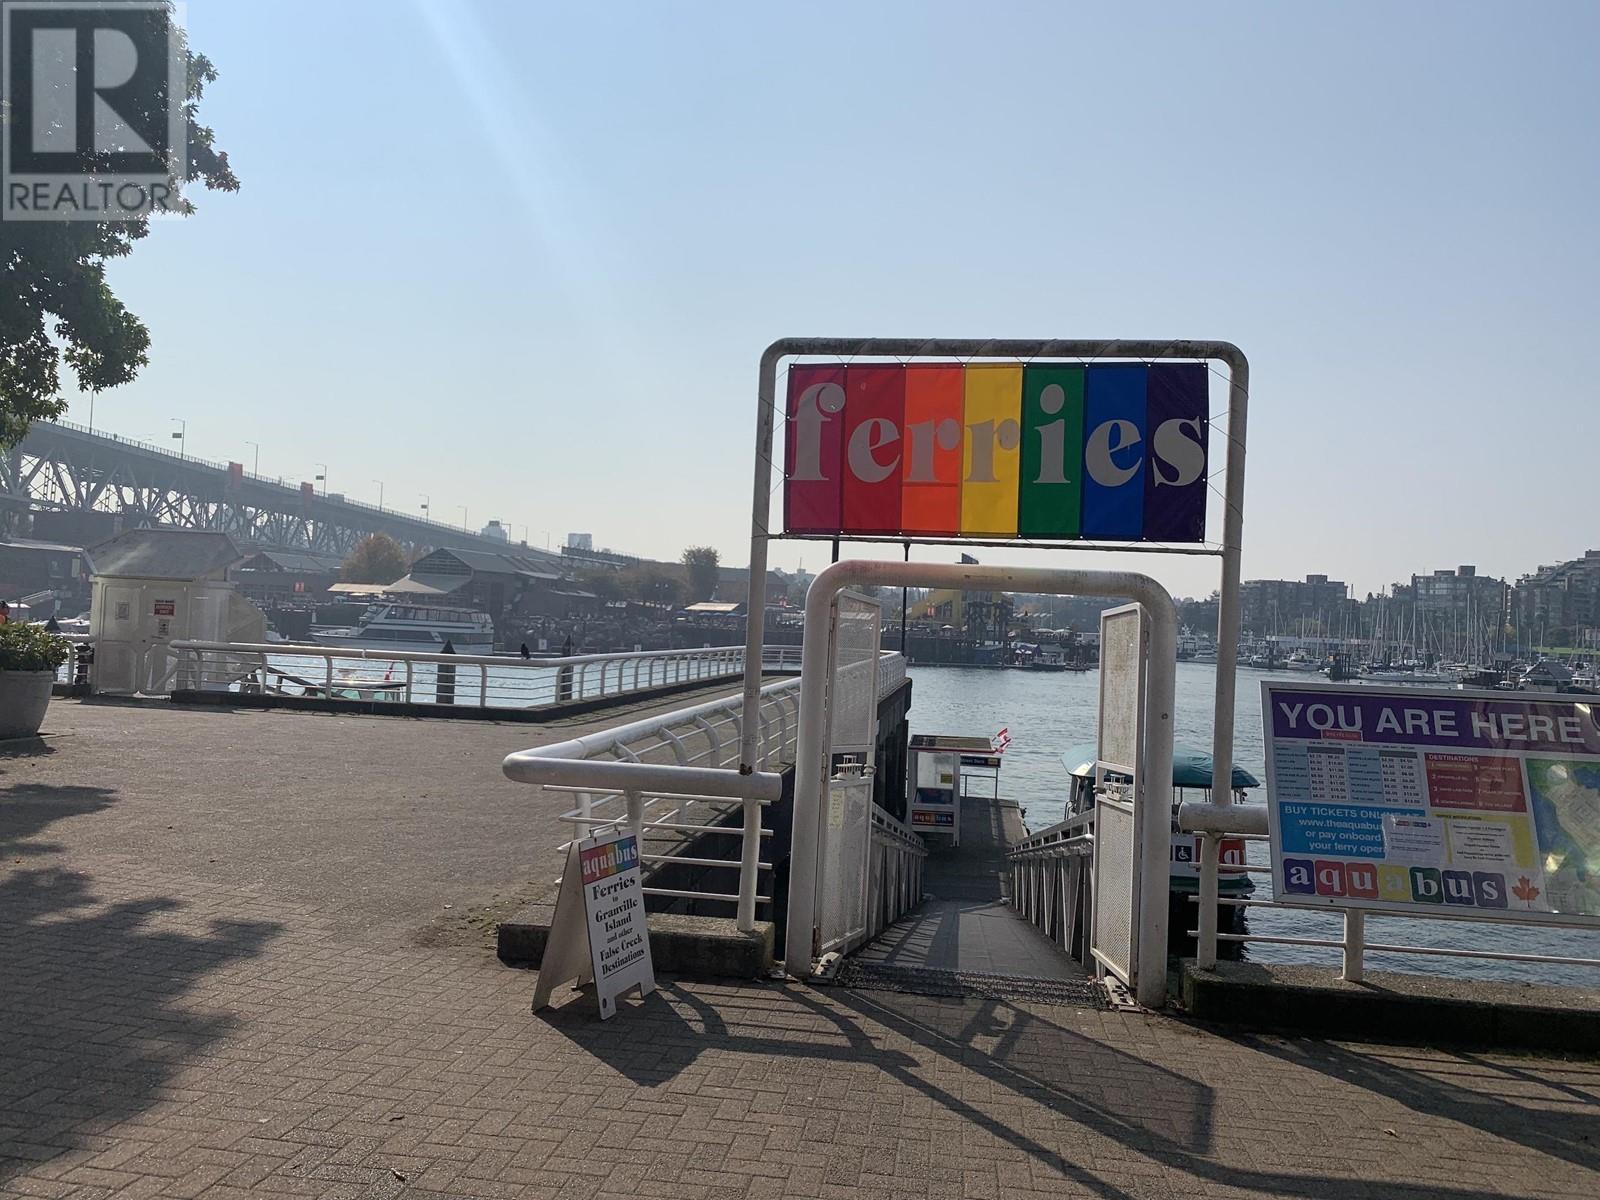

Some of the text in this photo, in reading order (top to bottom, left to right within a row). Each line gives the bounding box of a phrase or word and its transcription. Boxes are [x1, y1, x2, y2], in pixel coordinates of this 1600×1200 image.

[788, 382, 1205, 487] ferries
[1279, 702, 1586, 744] YOU ARE HERE
[1428, 754, 1479, 763] DESTINATIONS
[1285, 805, 1307, 815] BUY
[1312, 807, 1357, 818] TICKETS
[1298, 819, 1383, 831] www.theaquabu
[1318, 831, 1336, 841] pay
[1339, 832, 1381, 841] onboard
[582, 843, 638, 877] aquabus
[1309, 842, 1385, 854] your ferry oper
[592, 874, 636, 900] Ferries
[1290, 866, 1499, 900] aquabus
[595, 898, 638, 923] Granville
[604, 912, 632, 933] Island
[606, 927, 633, 944] and other
[600, 935, 643, 962] False Creek
[601, 947, 645, 975] Destinations
